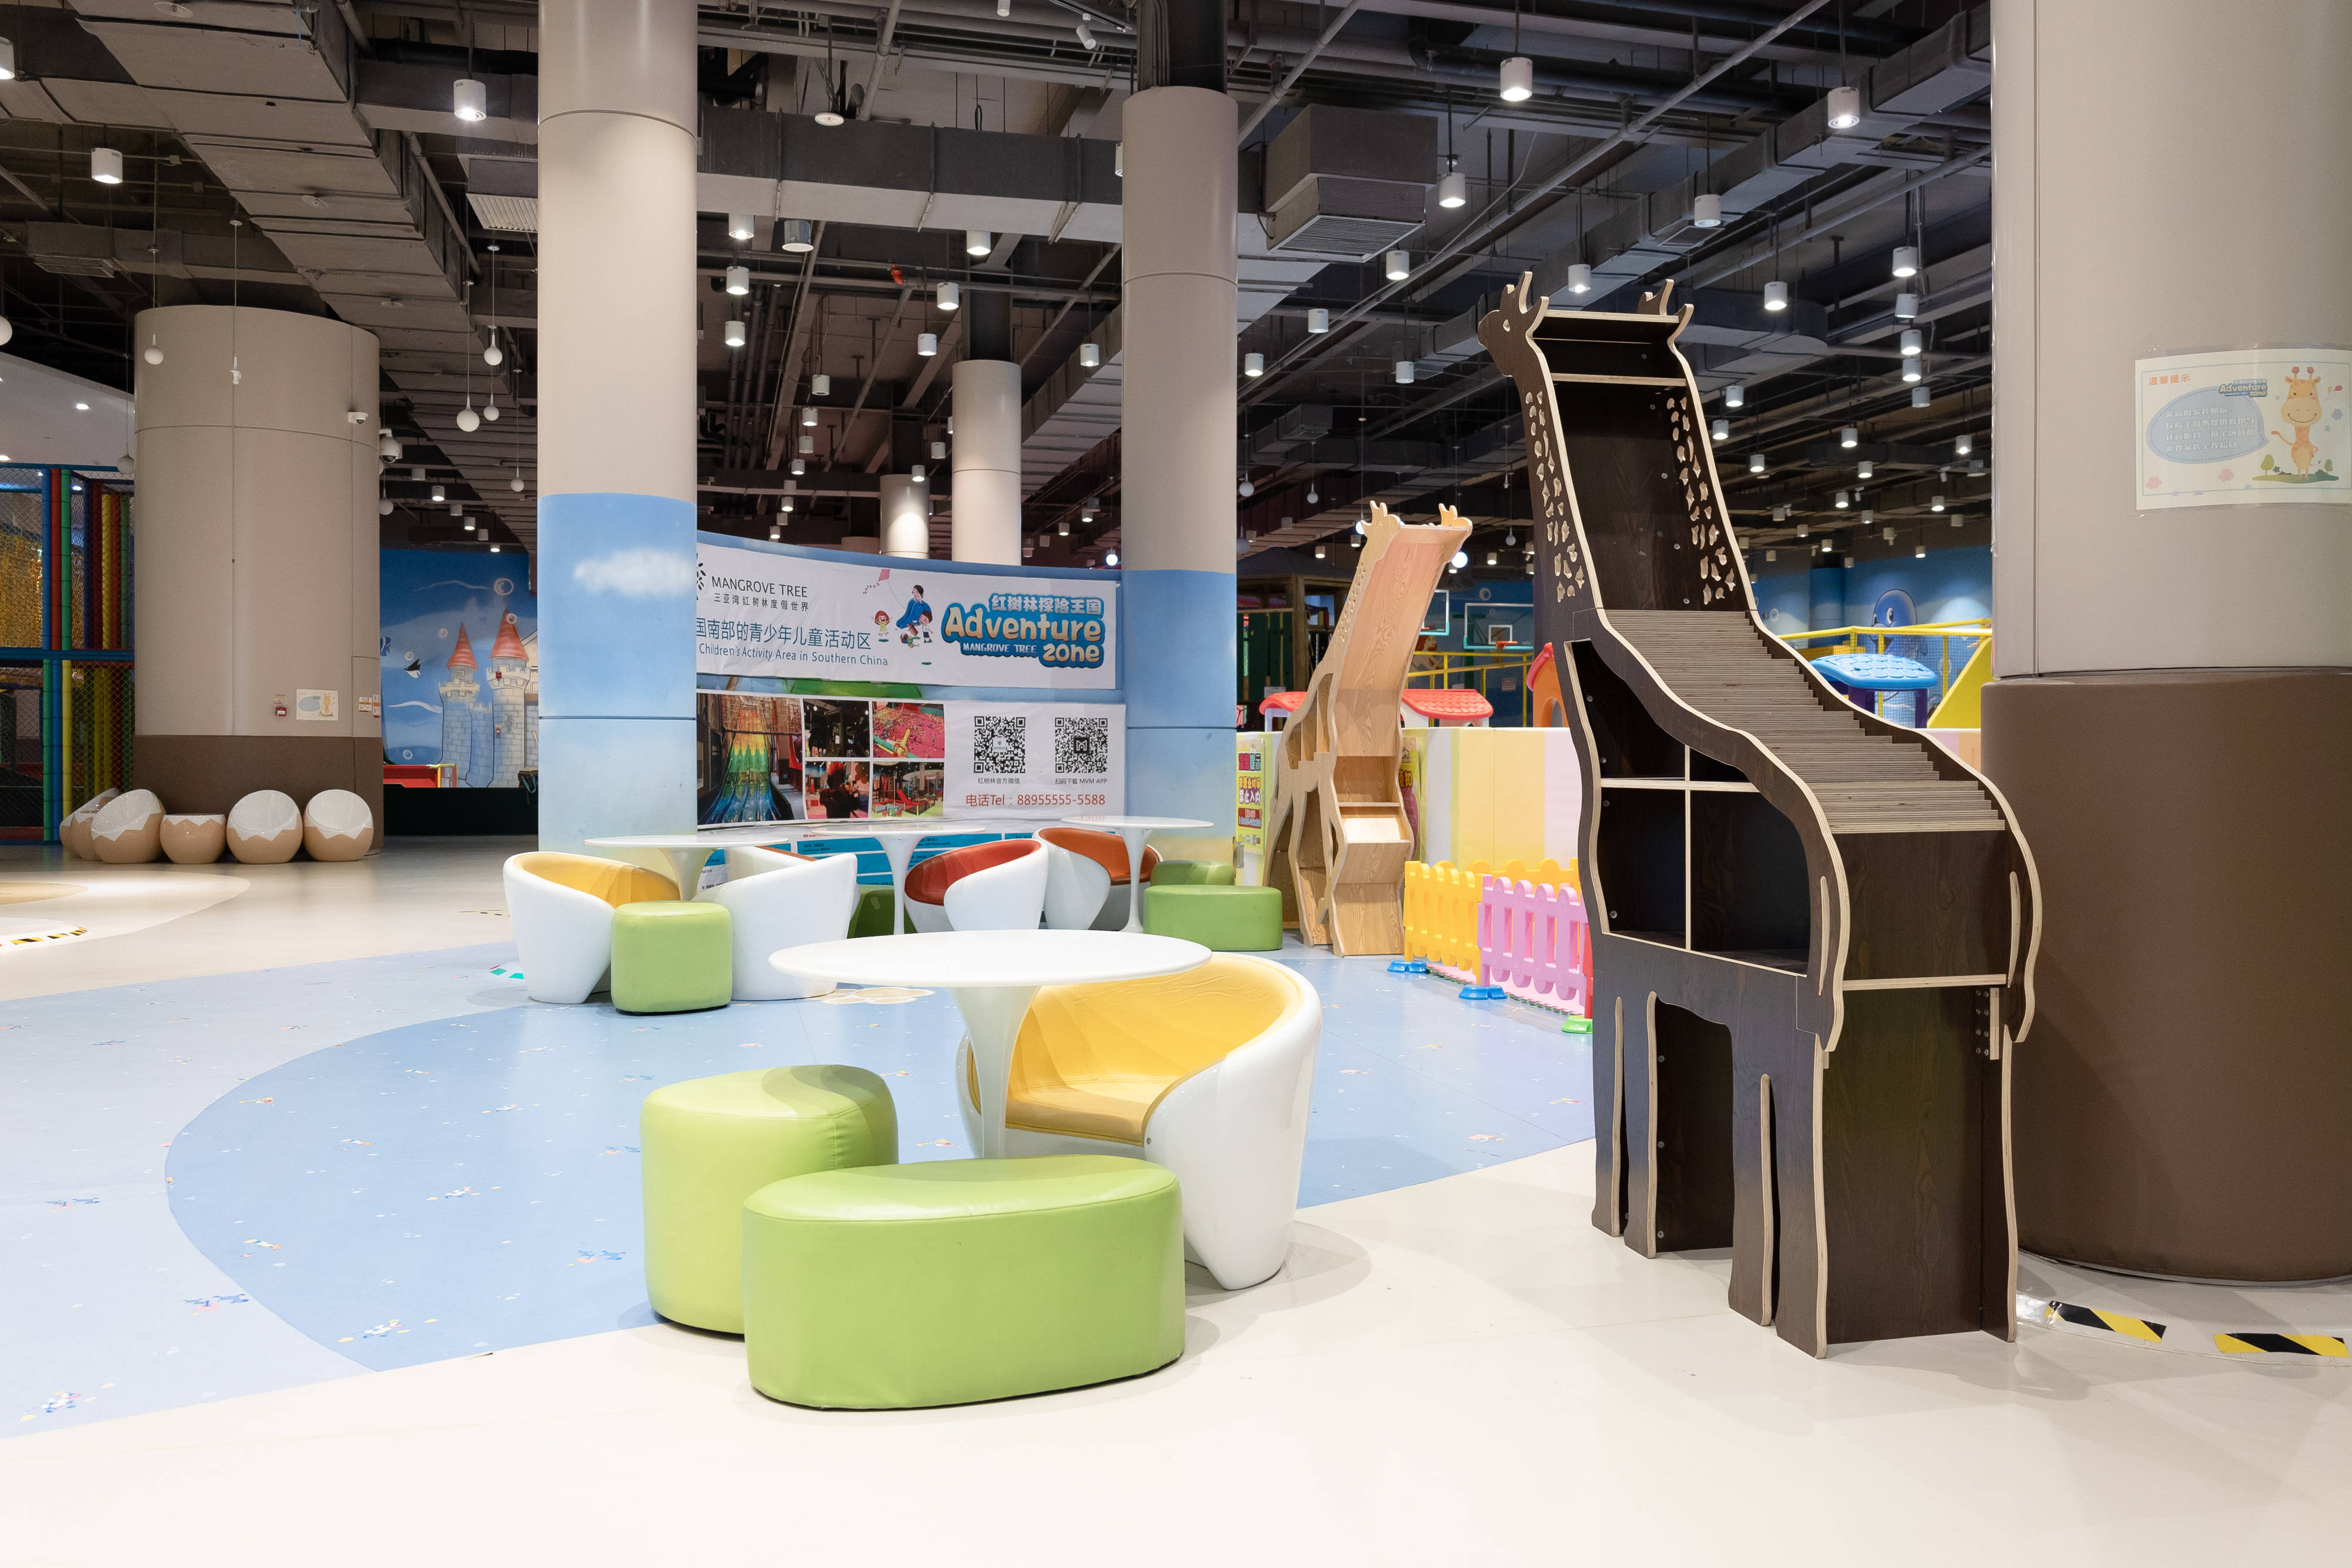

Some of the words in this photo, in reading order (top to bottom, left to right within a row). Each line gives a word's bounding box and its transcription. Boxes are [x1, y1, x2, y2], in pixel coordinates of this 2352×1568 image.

[2149, 374, 2190, 385] 温馨提示
[711, 576, 775, 594] MANGROVE
[779, 584, 808, 598] TREE
[714, 593, 808, 612] 三亚湾红树林度假世界
[991, 595, 1102, 615] 红树林探险王国
[944, 607, 1102, 642] Adventure
[699, 643, 740, 657] Children's
[742, 647, 773, 661] Activity
[776, 648, 796, 661] Area
[800, 650, 808, 661] in
[812, 651, 856, 664] Southern
[860, 654, 888, 666] China
[963, 643, 1010, 653] MANGROVE
[1013, 644, 1037, 654] TREE
[1238, 788, 1261, 804] 禁止入内
